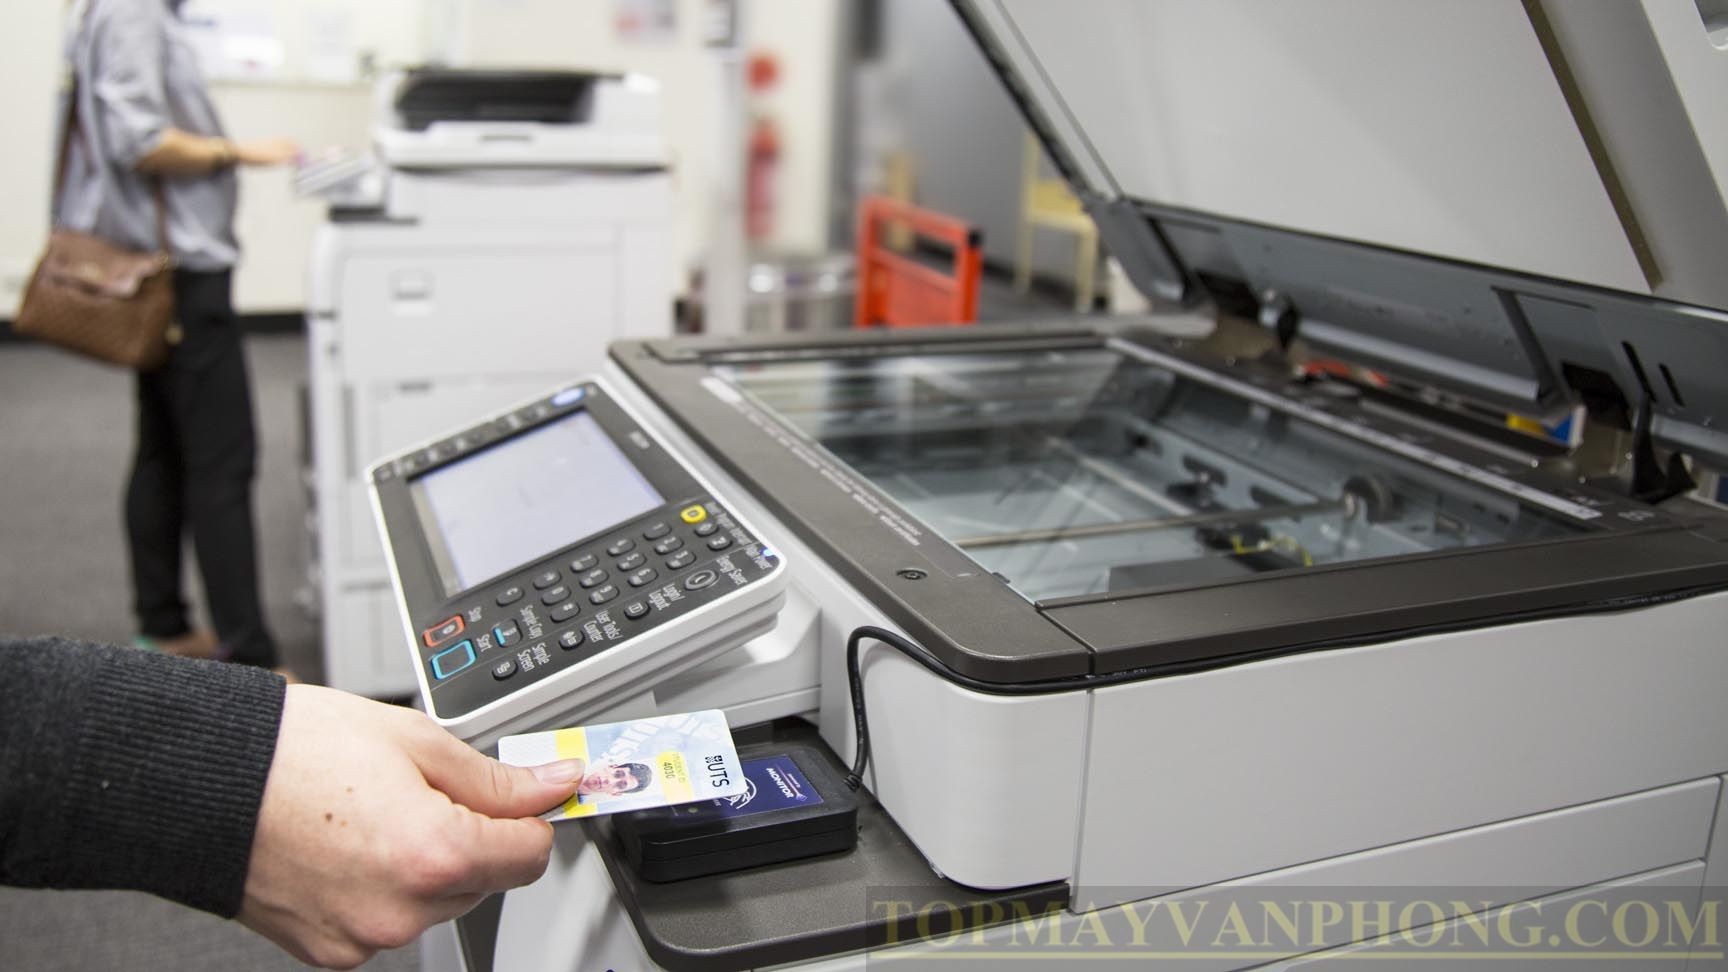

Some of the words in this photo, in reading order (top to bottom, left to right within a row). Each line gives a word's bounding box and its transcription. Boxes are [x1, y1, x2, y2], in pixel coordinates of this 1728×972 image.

[716, 555, 735, 573] Energy
[728, 568, 748, 586] Saver
[752, 555, 773, 571] Power
[649, 589, 670, 611] Logout
[663, 583, 685, 602] Login/
[468, 606, 482, 622] Stop
[520, 604, 539, 627] Sample
[594, 609, 611, 625] User
[603, 621, 624, 641] Tools/
[528, 621, 544, 639] Copy
[583, 619, 604, 643] Counter
[476, 633, 493, 652] Start
[532, 642, 552, 665] Simple
[517, 648, 535, 672] Screen
[707, 761, 730, 788] UTS
[766, 767, 794, 799] MONITOR
